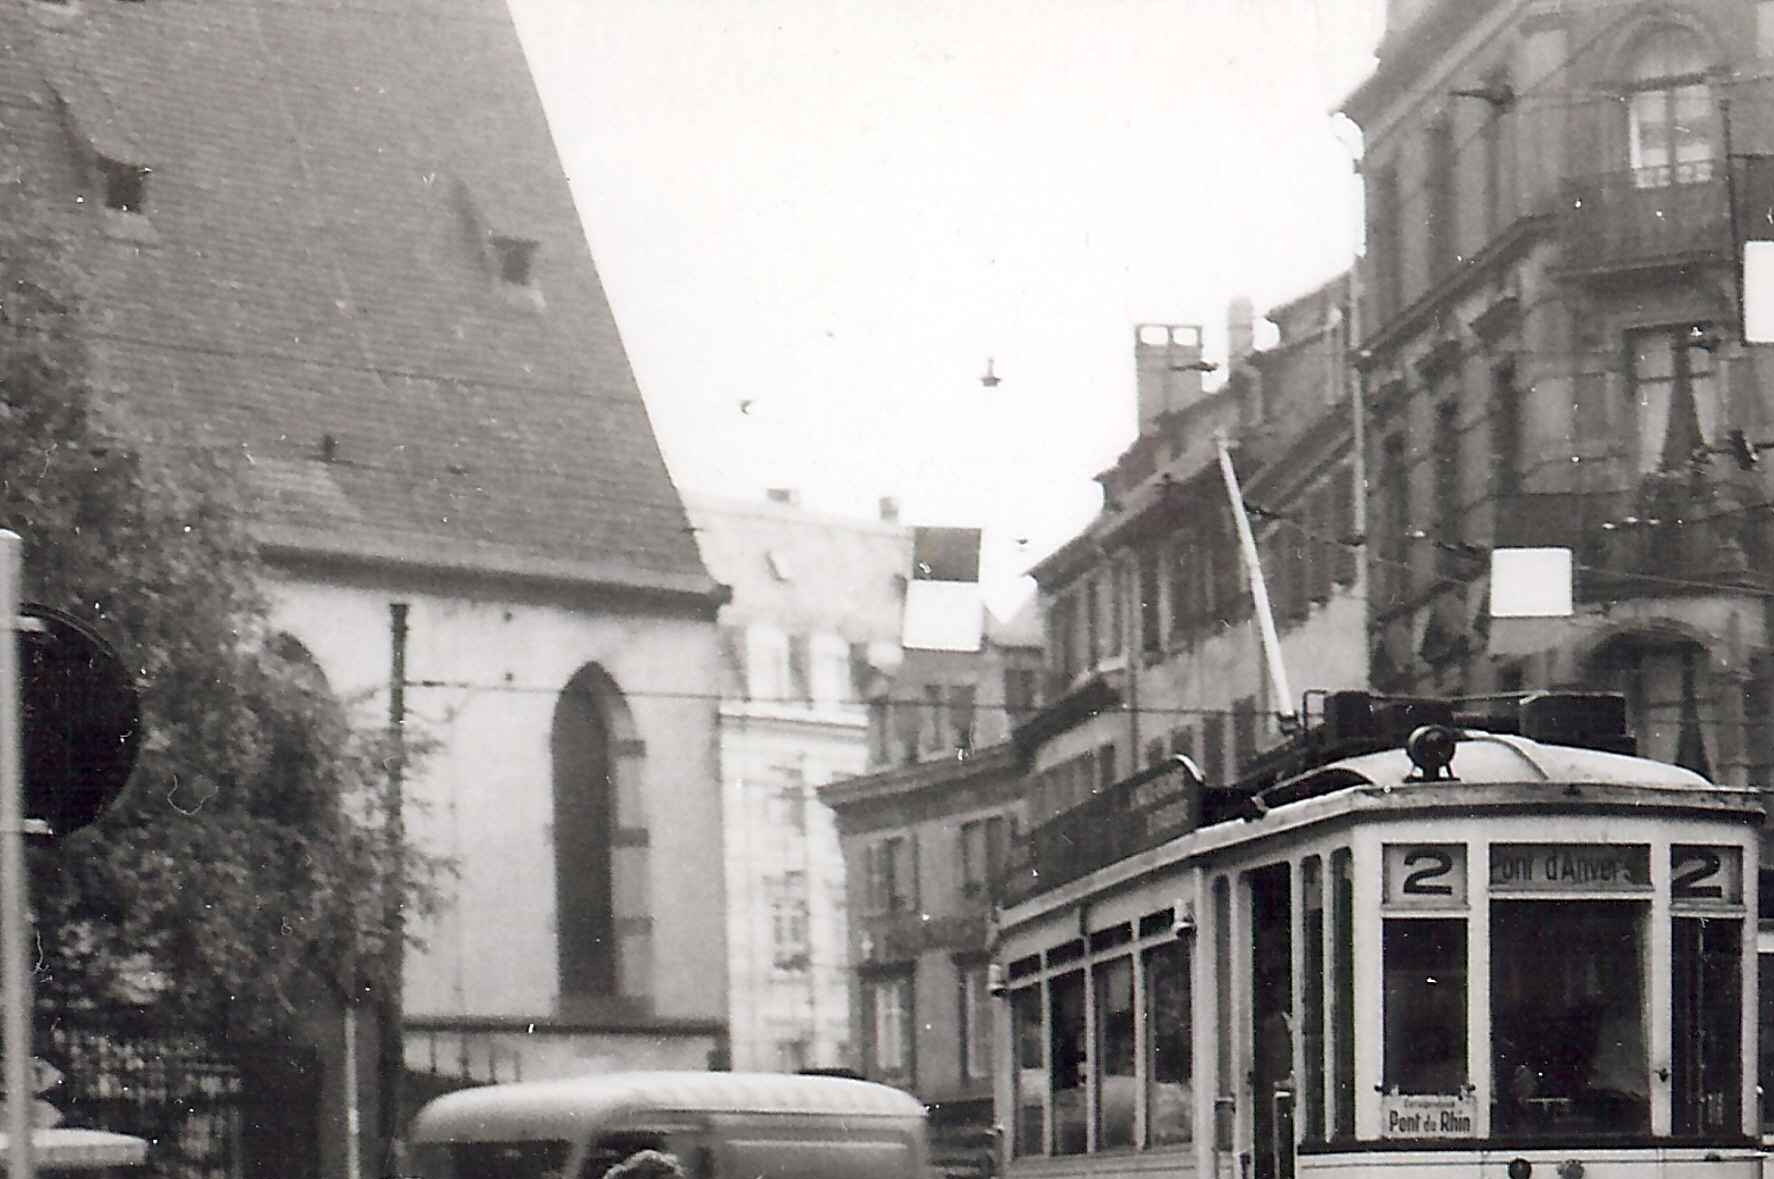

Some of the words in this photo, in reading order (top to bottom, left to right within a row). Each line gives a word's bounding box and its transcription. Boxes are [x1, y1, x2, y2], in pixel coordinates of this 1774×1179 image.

[1402, 847, 1453, 895] 2
[1670, 848, 1722, 898] 2
[1389, 1110, 1420, 1132] Pont
[1440, 1110, 1471, 1132] Rhin
